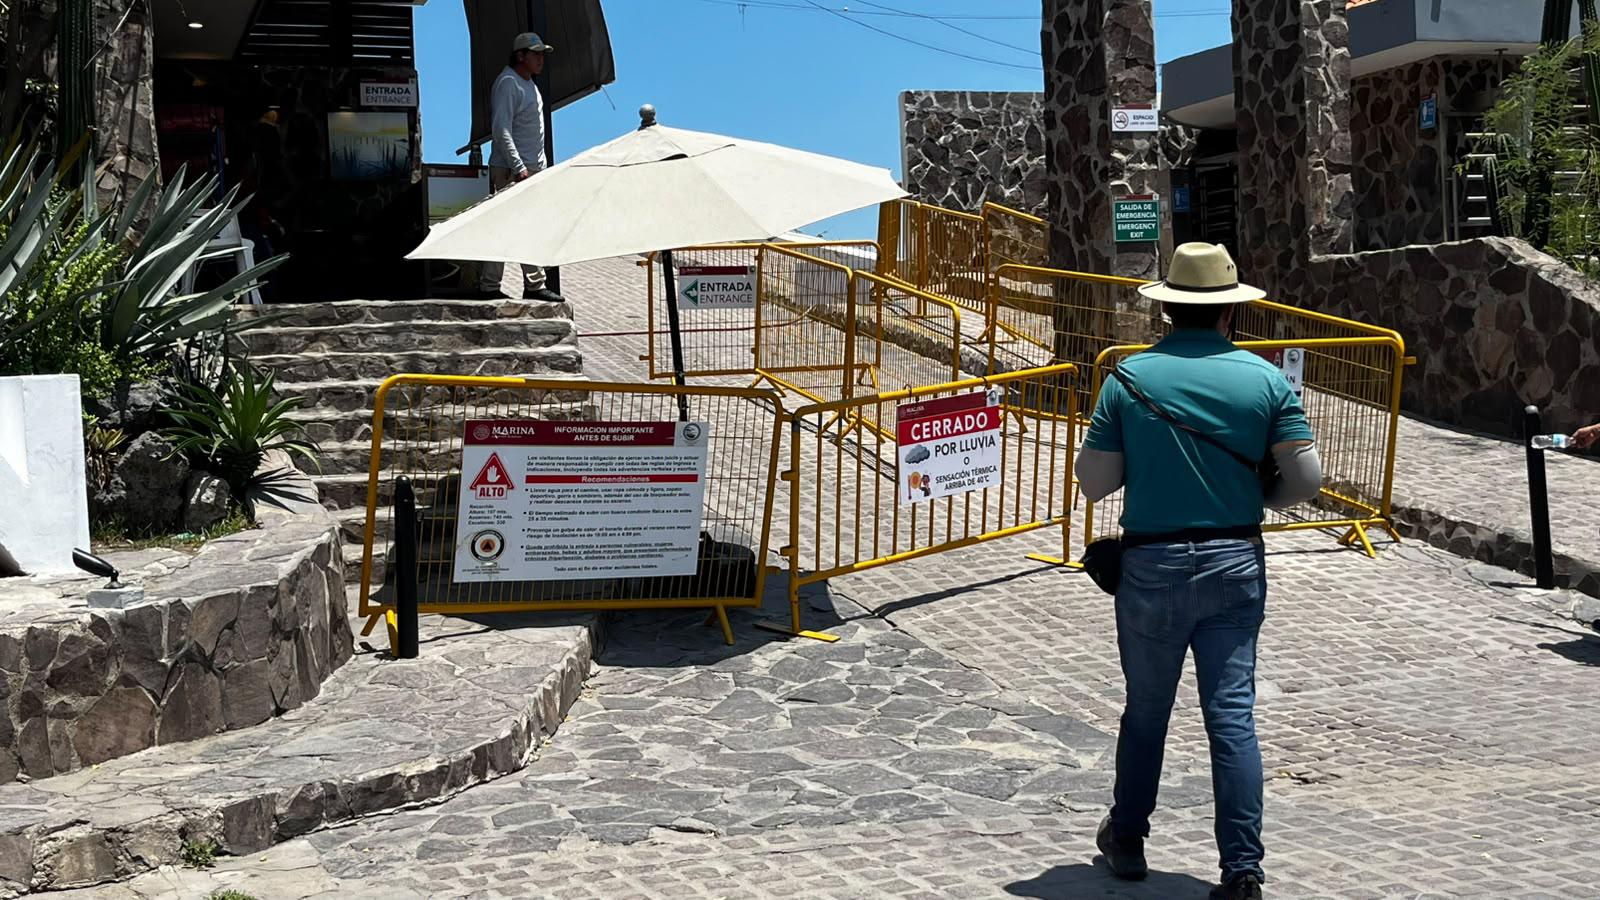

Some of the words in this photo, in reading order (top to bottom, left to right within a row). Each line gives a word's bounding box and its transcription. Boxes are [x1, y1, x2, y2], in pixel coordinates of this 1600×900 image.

[366, 87, 411, 95] ENTRADA
[367, 95, 412, 104] ENTRANCE
[1116, 211, 1157, 219] EMERGENCIA
[700, 282, 753, 292] ENTRADA
[700, 294, 753, 304] ENTRANCE
[491, 426, 535, 435] MARINA
[554, 426, 607, 434] INFORMACION
[910, 411, 988, 441] CERRADO
[935, 441, 957, 457] POR
[960, 434, 996, 453] LLUVIA
[963, 456, 970, 465] O
[935, 469, 971, 484] SENSACIÓN
[971, 465, 998, 478] TÉRMICA
[944, 481, 967, 491] ARRIBA
[967, 478, 976, 487] DE
[478, 487, 505, 497] ALTO
